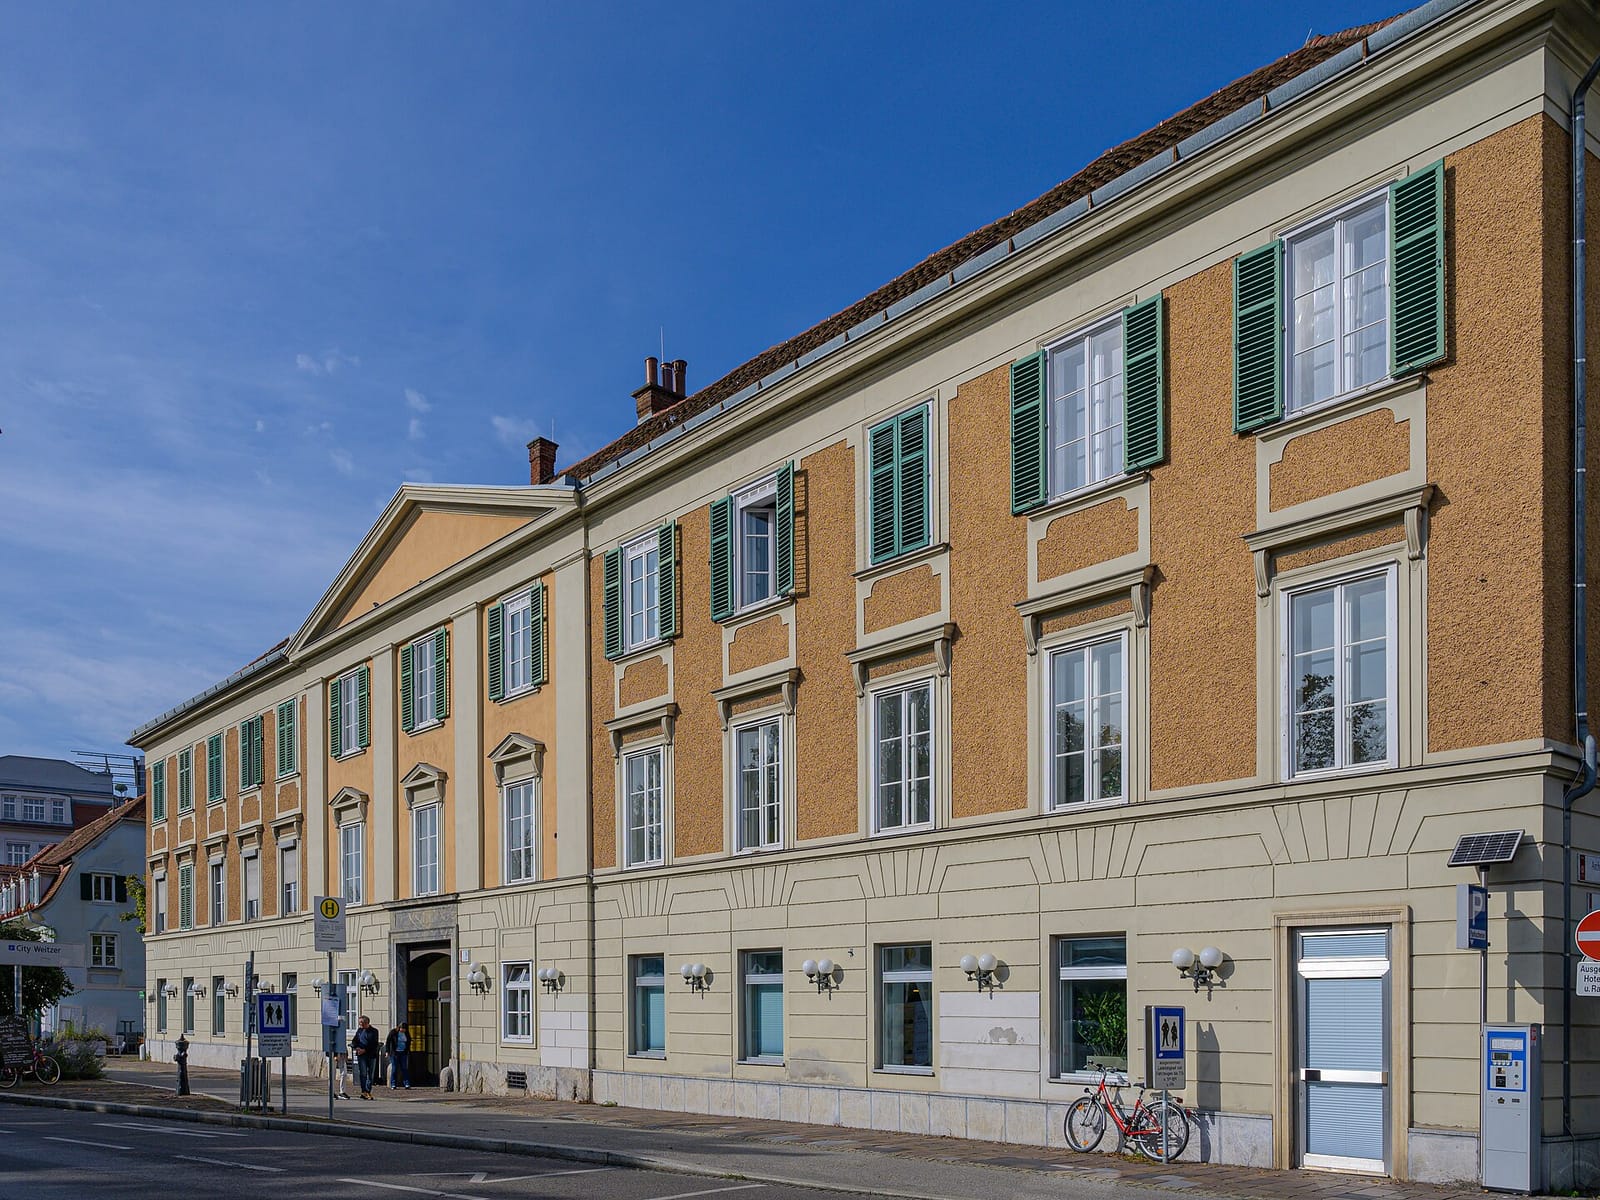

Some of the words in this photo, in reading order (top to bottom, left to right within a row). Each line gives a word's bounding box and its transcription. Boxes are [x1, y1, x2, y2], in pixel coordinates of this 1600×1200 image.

[325, 902, 334, 915] H
[16, 944, 31, 954] City
[33, 945, 61, 953] Weitzer
